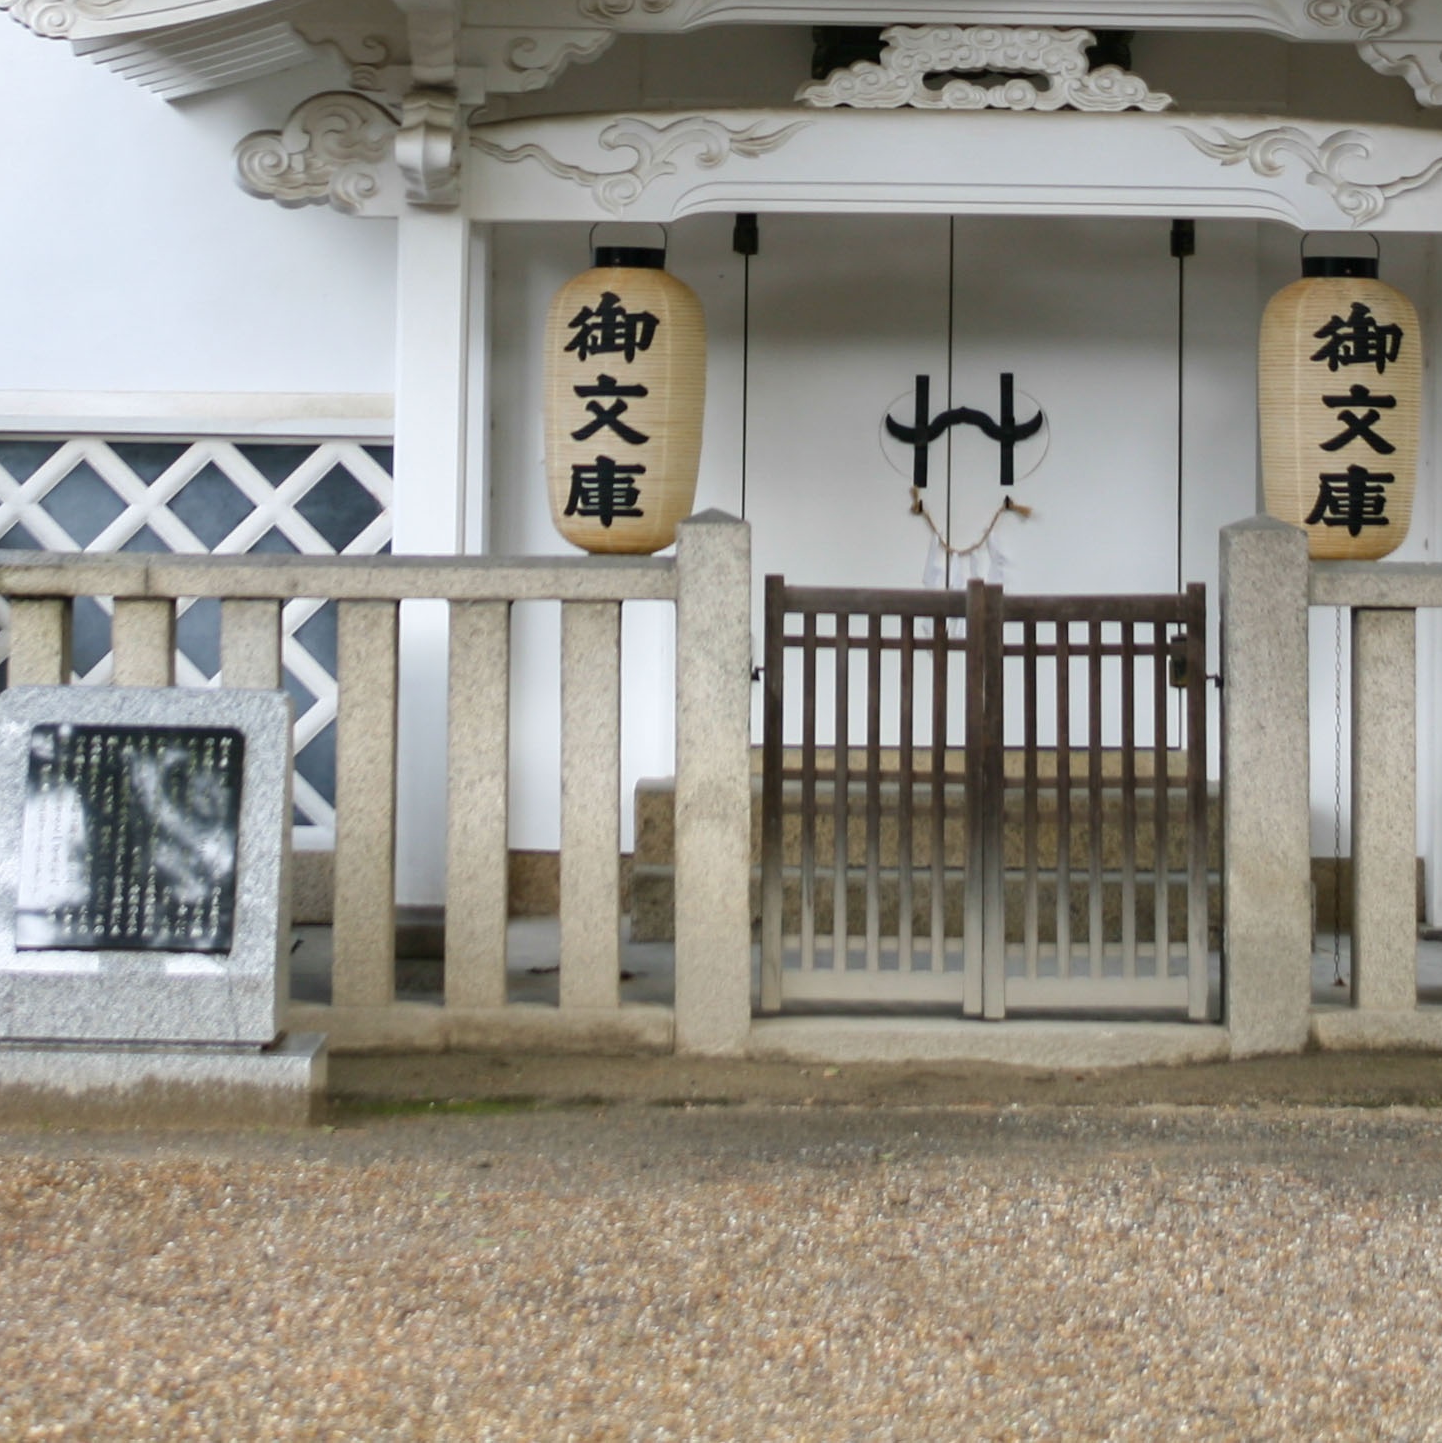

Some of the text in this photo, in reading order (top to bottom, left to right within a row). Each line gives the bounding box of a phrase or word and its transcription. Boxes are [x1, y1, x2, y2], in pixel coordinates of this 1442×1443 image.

[563, 291, 660, 529] 御文庫
[1304, 301, 1404, 538] 御文庫
